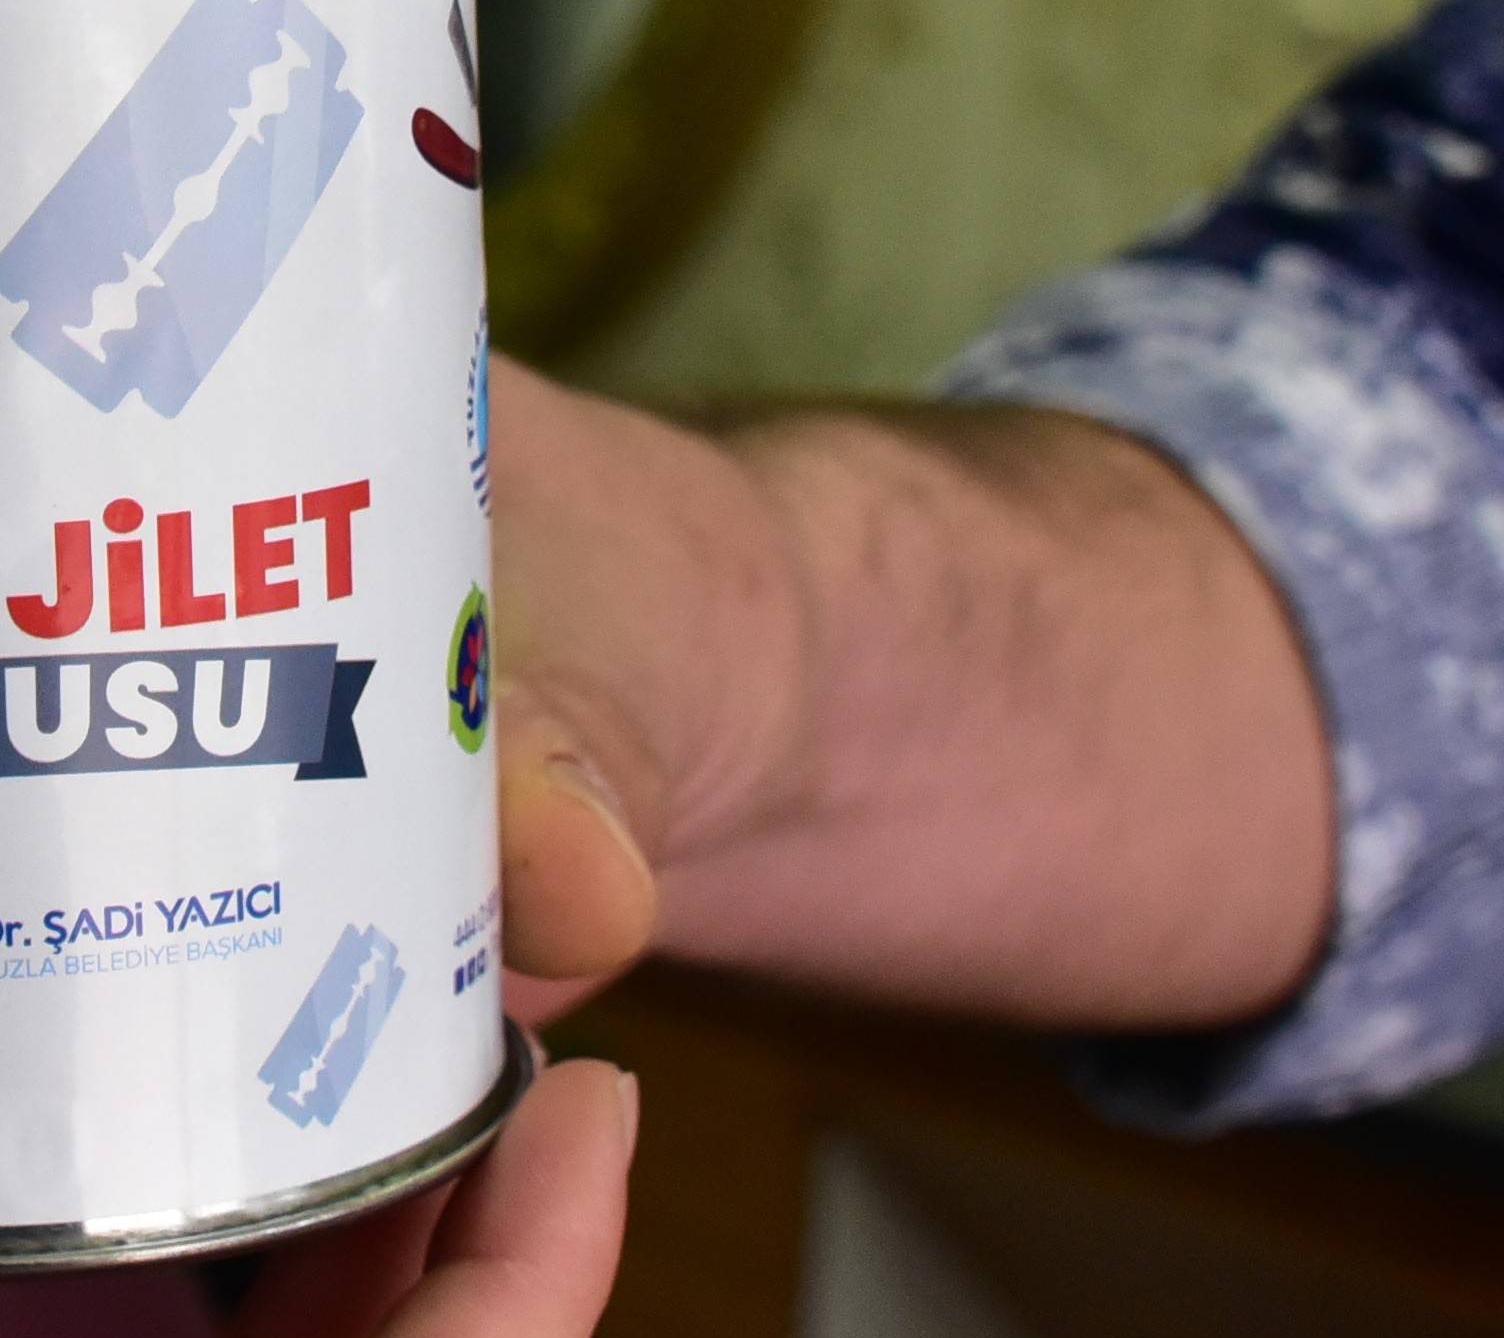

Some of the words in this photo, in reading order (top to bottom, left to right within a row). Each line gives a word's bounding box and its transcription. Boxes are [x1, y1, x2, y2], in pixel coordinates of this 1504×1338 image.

[154, 881, 281, 933] YAZICI
[64, 944, 180, 976] BELEDİYE
[186, 927, 283, 962] BAŞKANI
